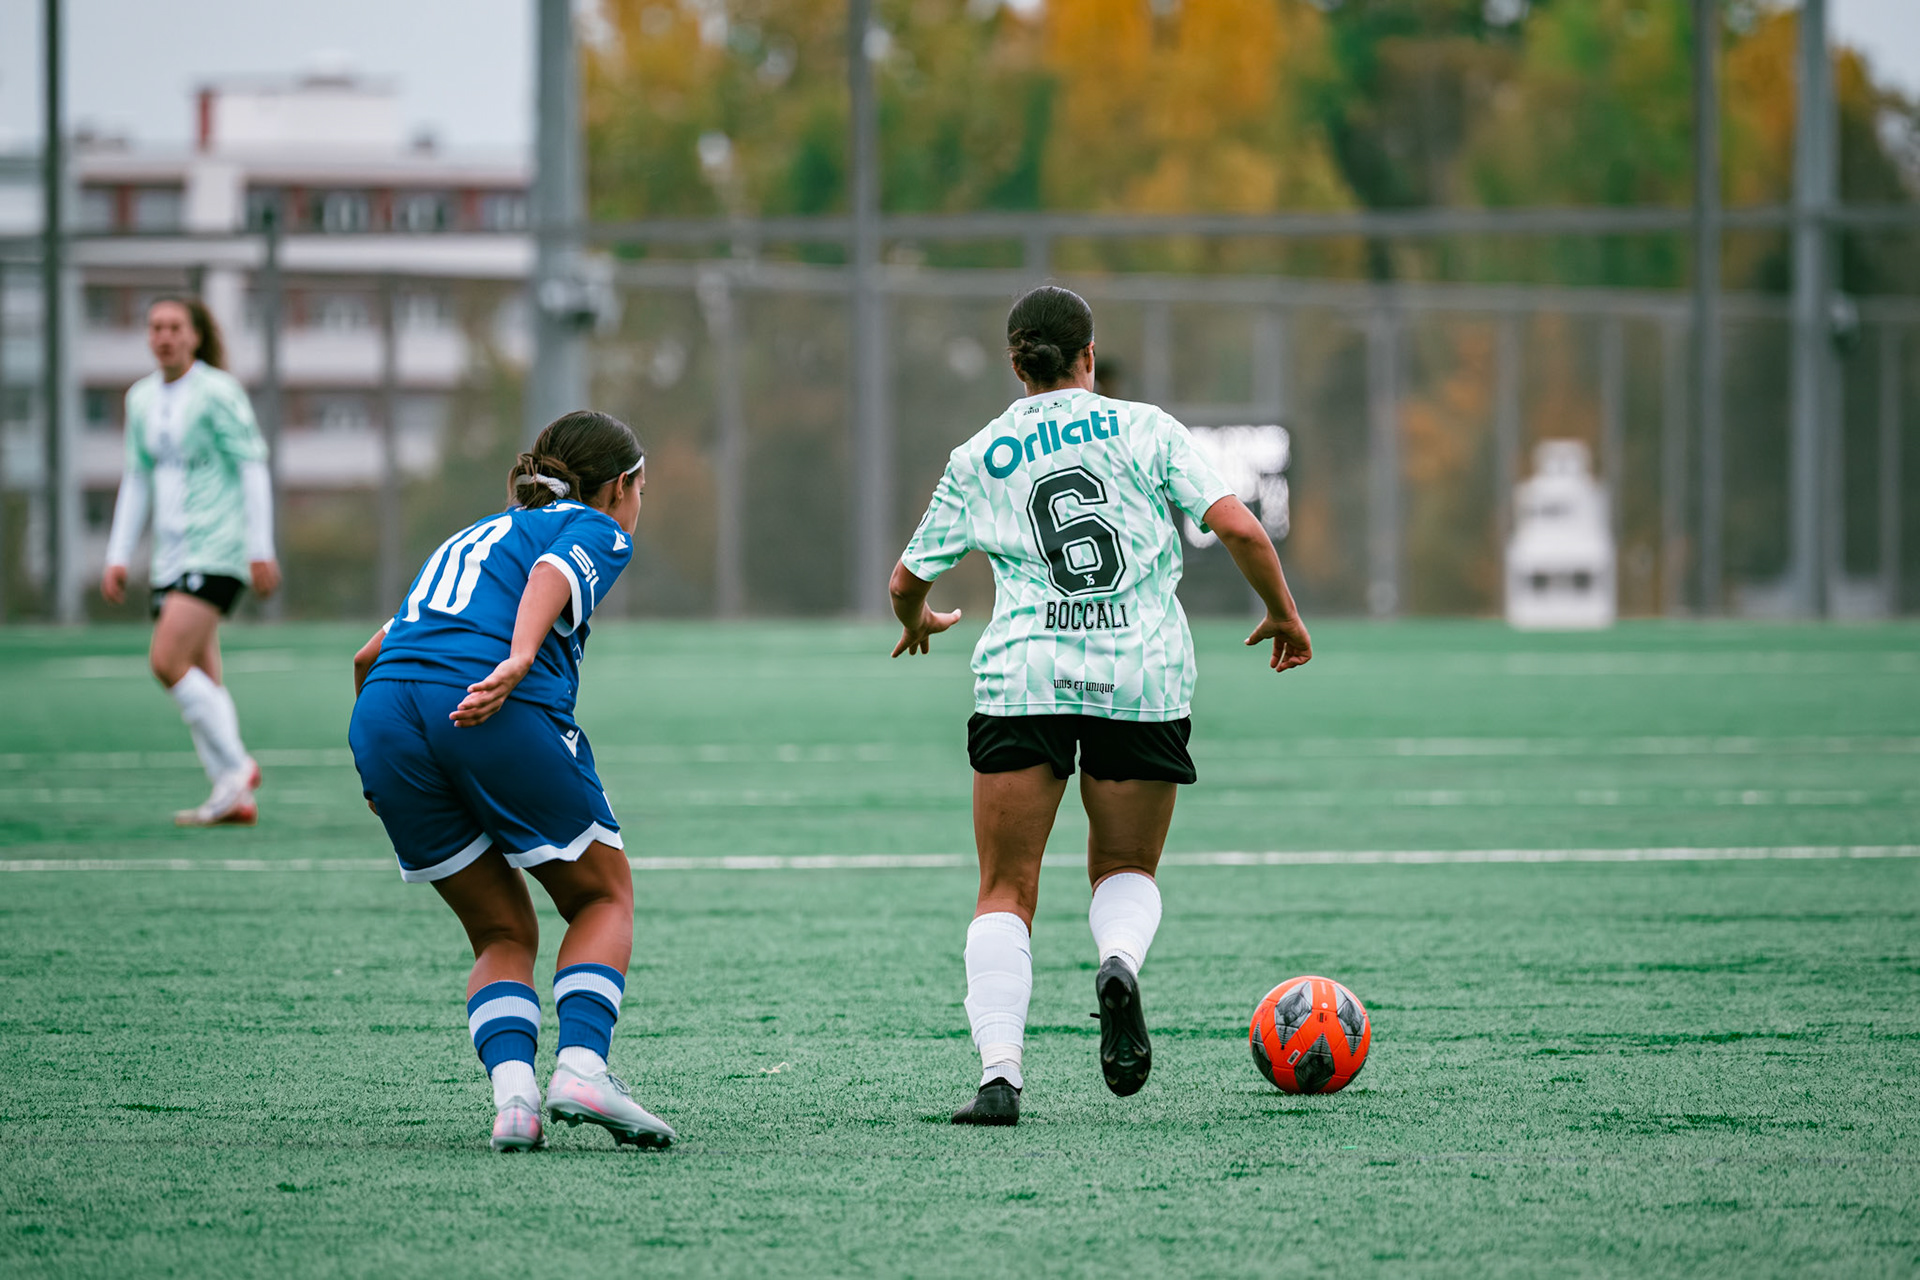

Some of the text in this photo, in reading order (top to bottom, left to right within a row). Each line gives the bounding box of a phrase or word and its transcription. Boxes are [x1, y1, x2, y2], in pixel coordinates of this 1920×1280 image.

[984, 410, 1120, 479] Orllati
[1027, 466, 1127, 597] 6
[403, 515, 513, 623] 10
[1044, 600, 1130, 632] BOCCALI
[1053, 679, 1115, 695] UNIS ET UNIQUE
